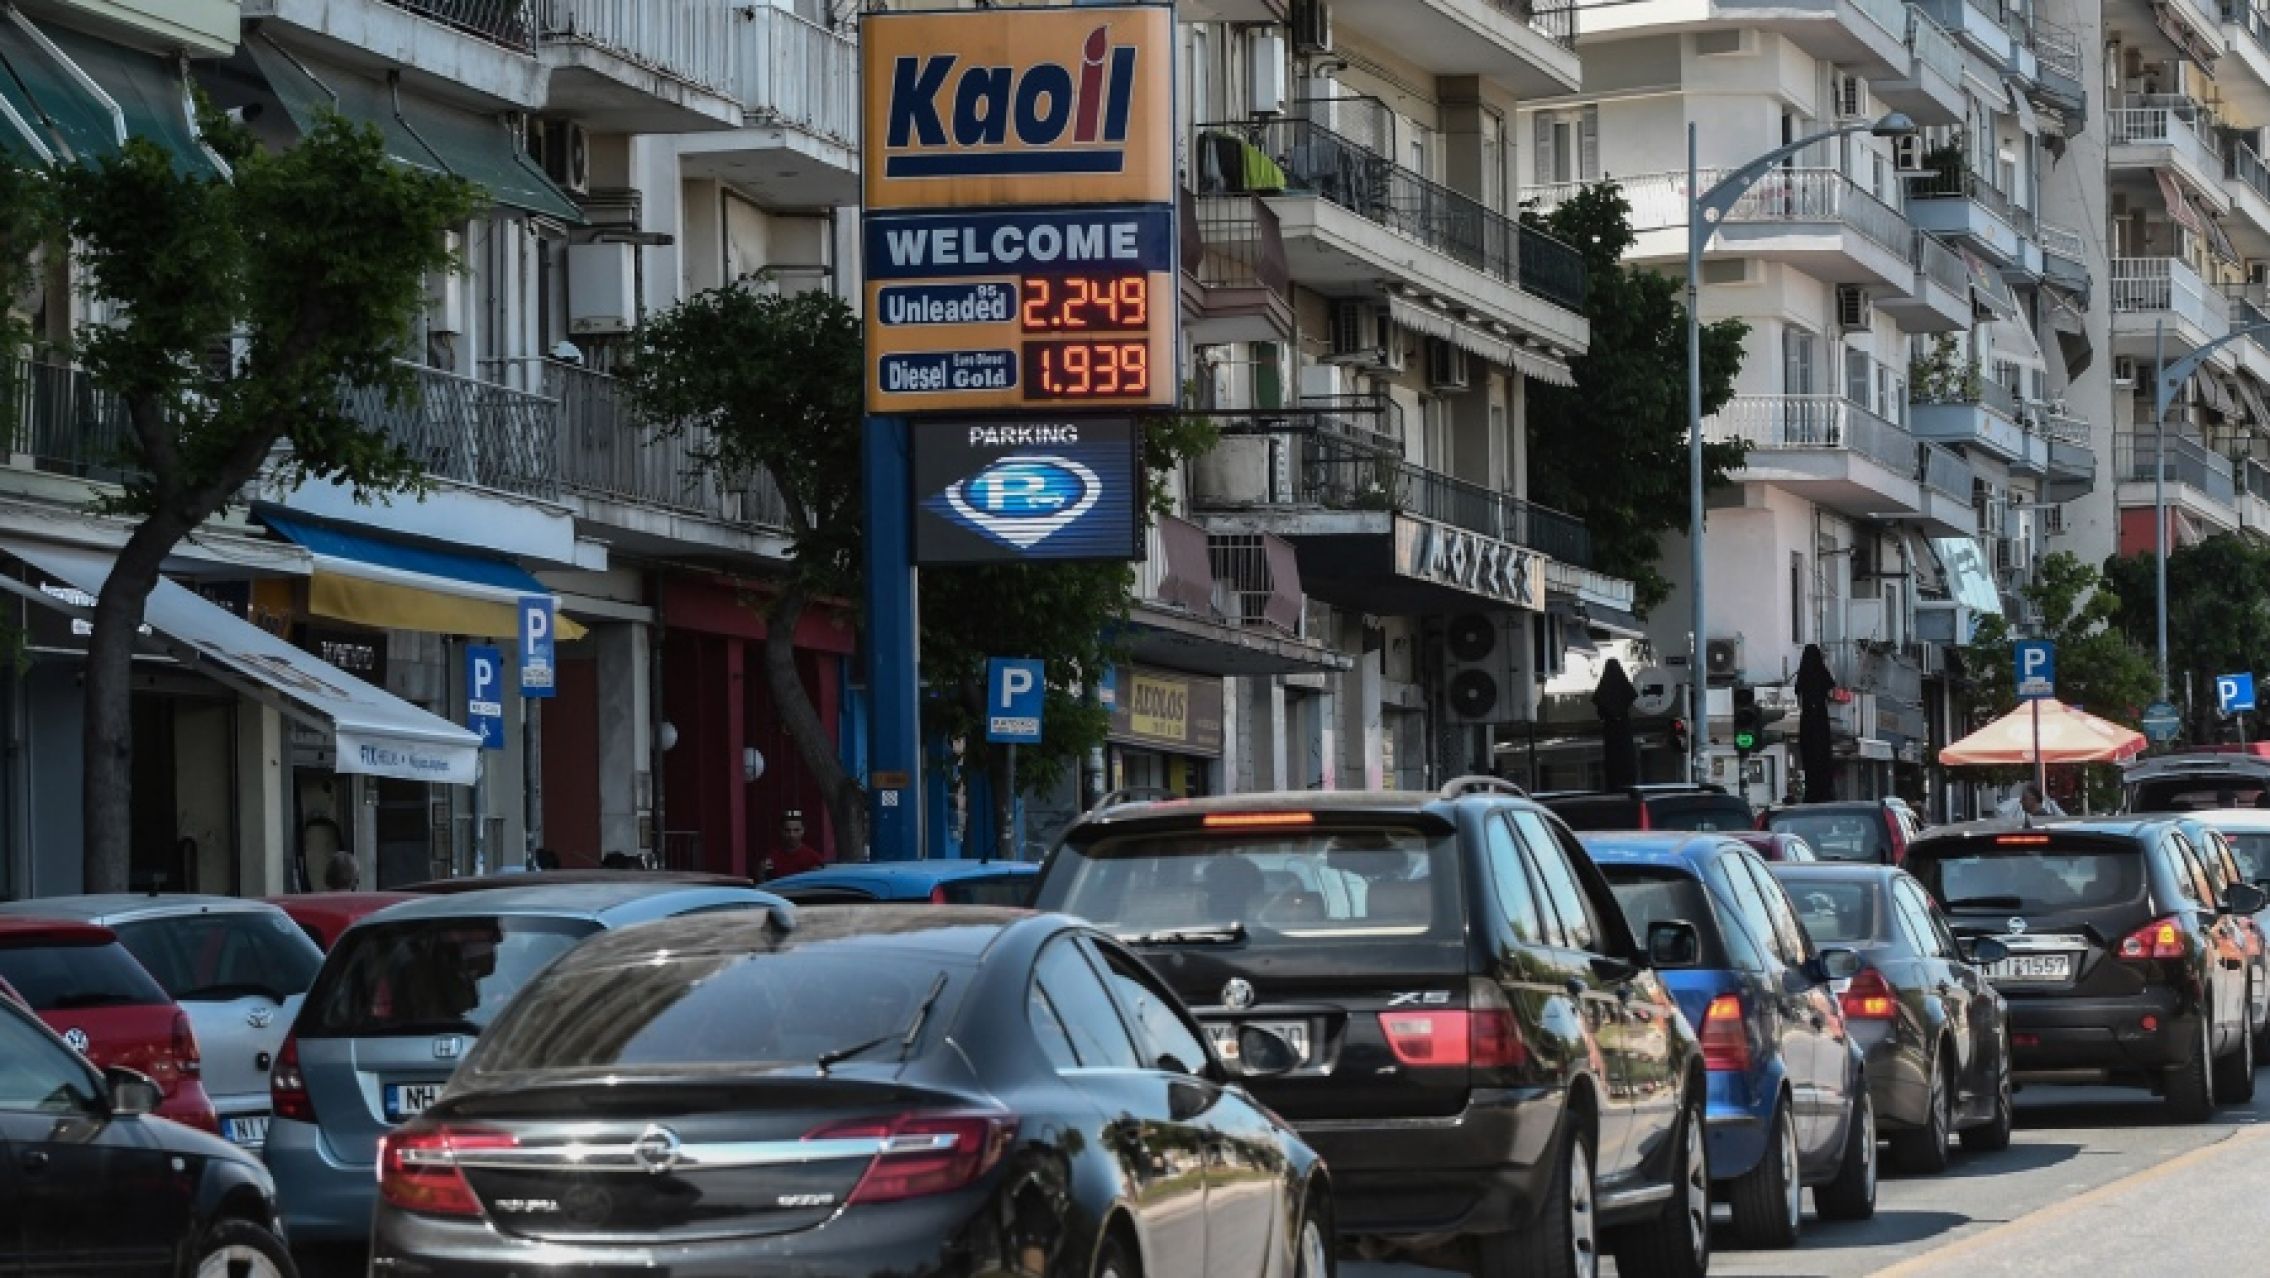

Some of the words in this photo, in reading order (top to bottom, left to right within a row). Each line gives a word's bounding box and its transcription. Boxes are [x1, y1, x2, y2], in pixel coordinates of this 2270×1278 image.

[886, 24, 1138, 147] Kaoil
[887, 222, 1139, 266] WELCOME
[888, 293, 1007, 324] Unleaded
[1023, 277, 1146, 327] 2.249
[889, 361, 946, 390] Diesel
[953, 368, 1007, 388] Gold
[1040, 345, 1146, 392] 1.939
[968, 423, 1079, 447] PARKING
[528, 609, 546, 654] P
[474, 659, 492, 697] P
[2025, 648, 2046, 676] P
[1001, 668, 1032, 707] P
[2218, 681, 2238, 710] P
[406, 1085, 438, 1110] NH
